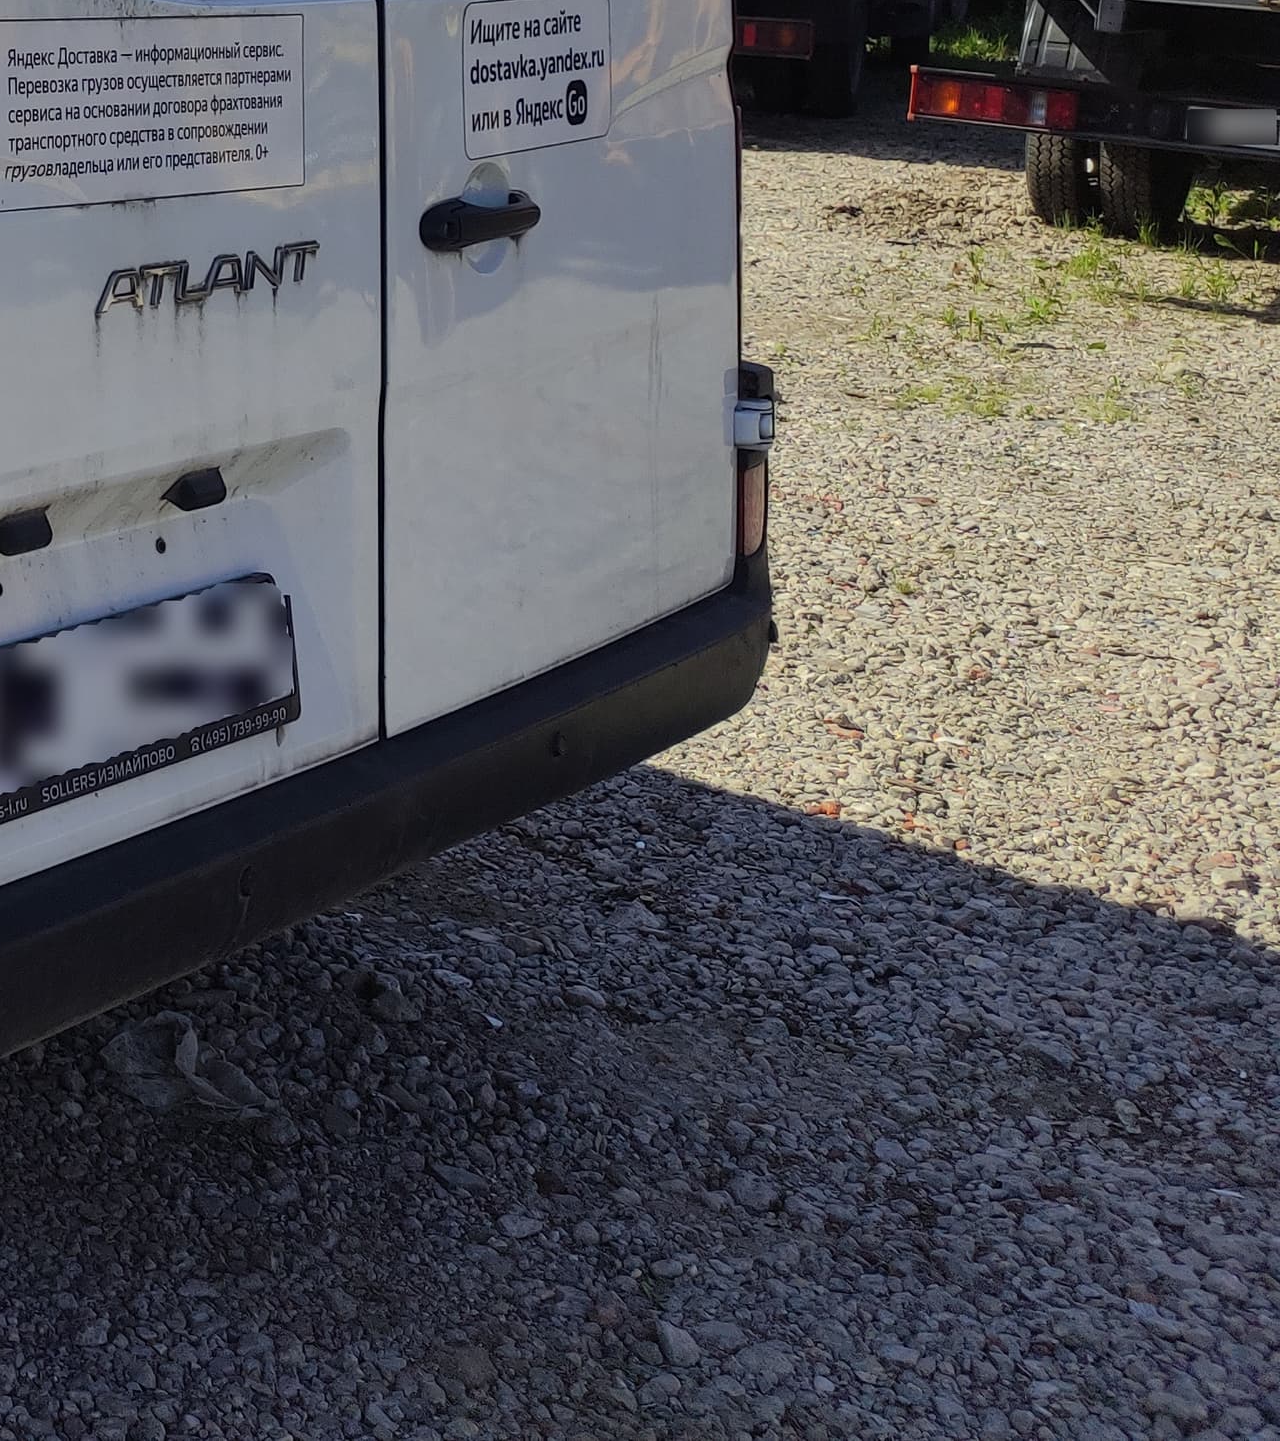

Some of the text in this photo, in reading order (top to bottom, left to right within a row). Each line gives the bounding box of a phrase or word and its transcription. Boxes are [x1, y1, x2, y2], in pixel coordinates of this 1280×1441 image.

[470, 9, 582, 46] Ищите на сайте
[7, 48, 56, 70] Яндекс
[57, 47, 118, 69] Доставка
[135, 42, 241, 65] информационный
[243, 44, 285, 62] сервис.
[470, 47, 605, 85] dostavka.yandex.ru
[7, 69, 292, 99] Перевозка грузов осуществляется партнерами
[7, 94, 283, 127] сервиса на основании договора фрахтования
[471, 89, 586, 133] или в Яндекс Go
[7, 121, 268, 156] транспортного средства в сопровождении
[4, 143, 269, 182] грузовладельца или его представителя. 0+
[95, 240, 320, 314] ATLANT
[41, 771, 97, 803] SOLLERS
[232, 707, 287, 738] 739-99-90
